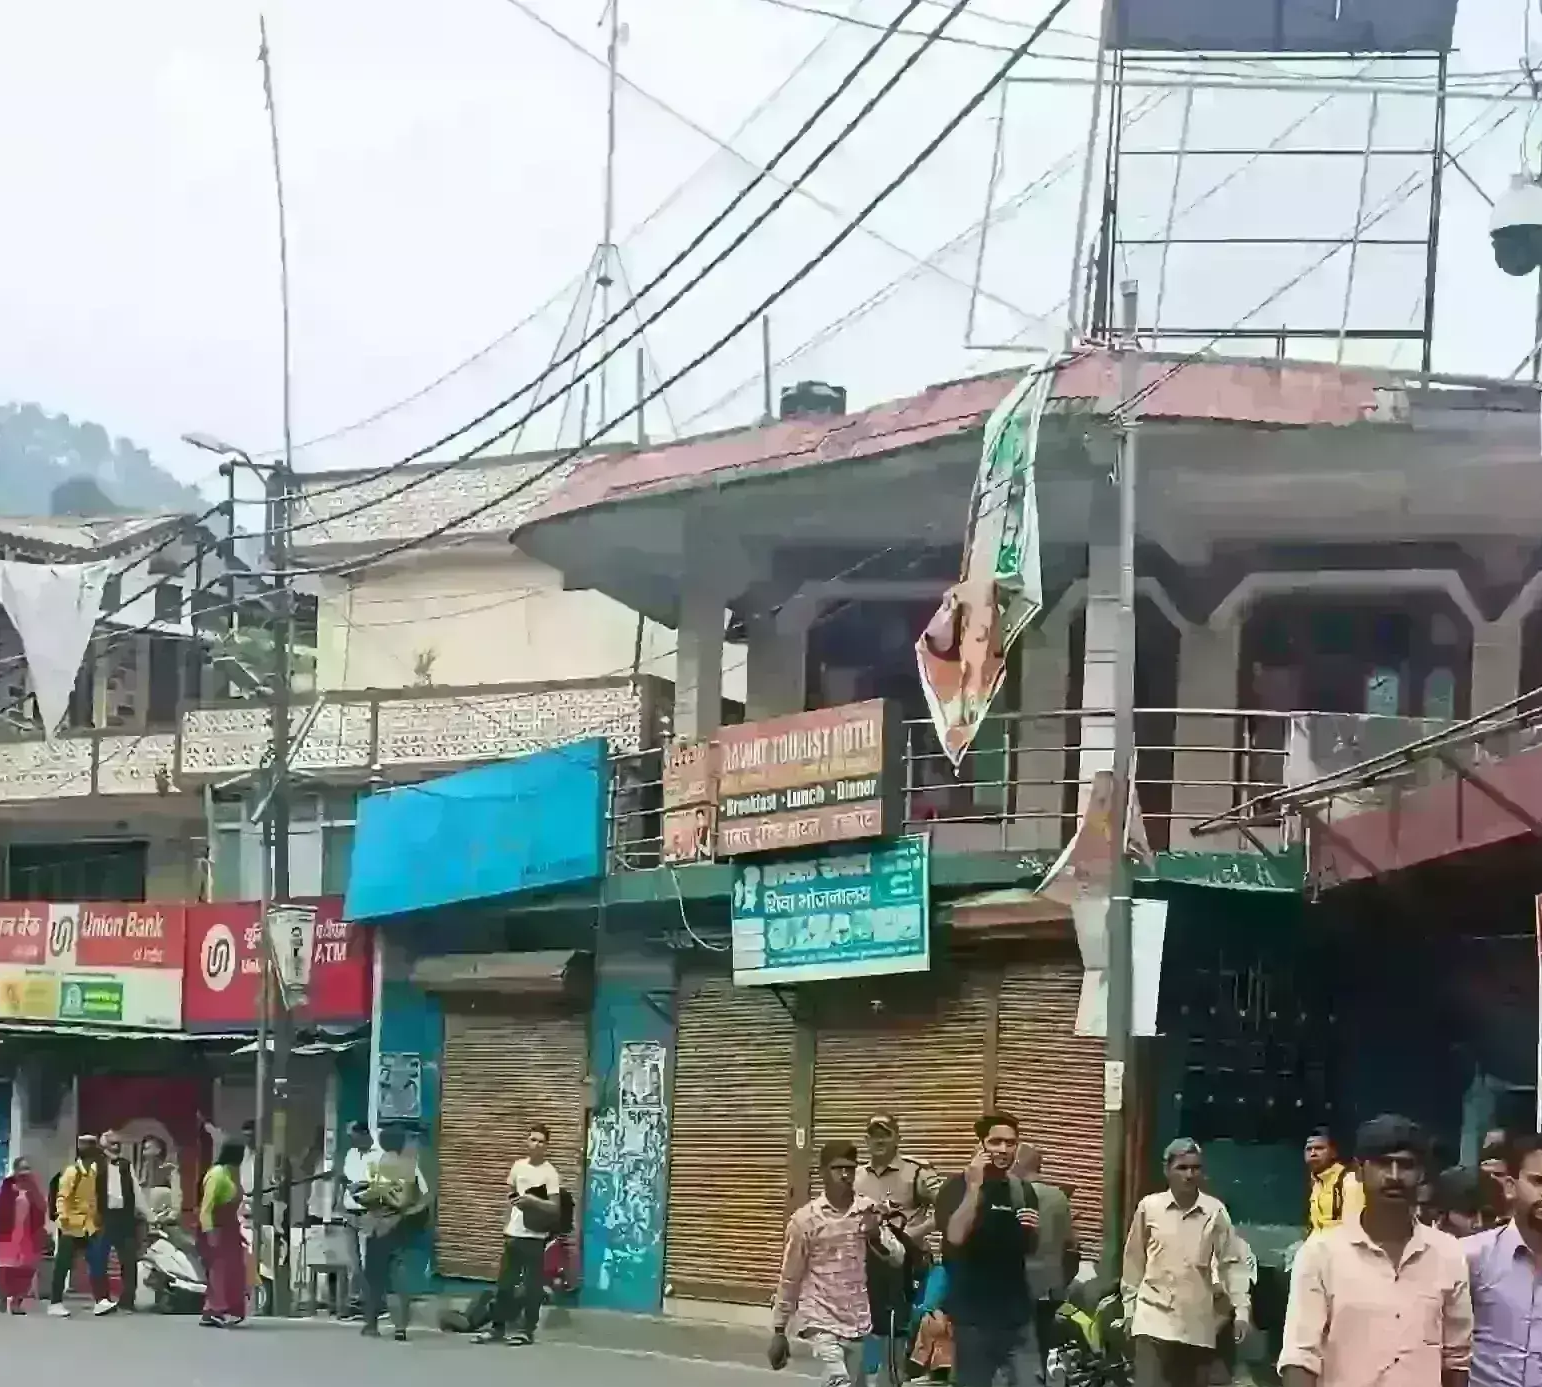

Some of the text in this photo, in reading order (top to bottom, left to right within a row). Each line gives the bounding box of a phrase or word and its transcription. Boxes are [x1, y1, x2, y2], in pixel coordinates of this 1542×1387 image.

[772, 726, 831, 764] TOURIST
[786, 784, 825, 808] Lunch
[836, 779, 877, 801] Dinner
[798, 886, 872, 911] भोजनालय
[81, 911, 164, 938] Union Bank
[315, 942, 348, 965] ATM
